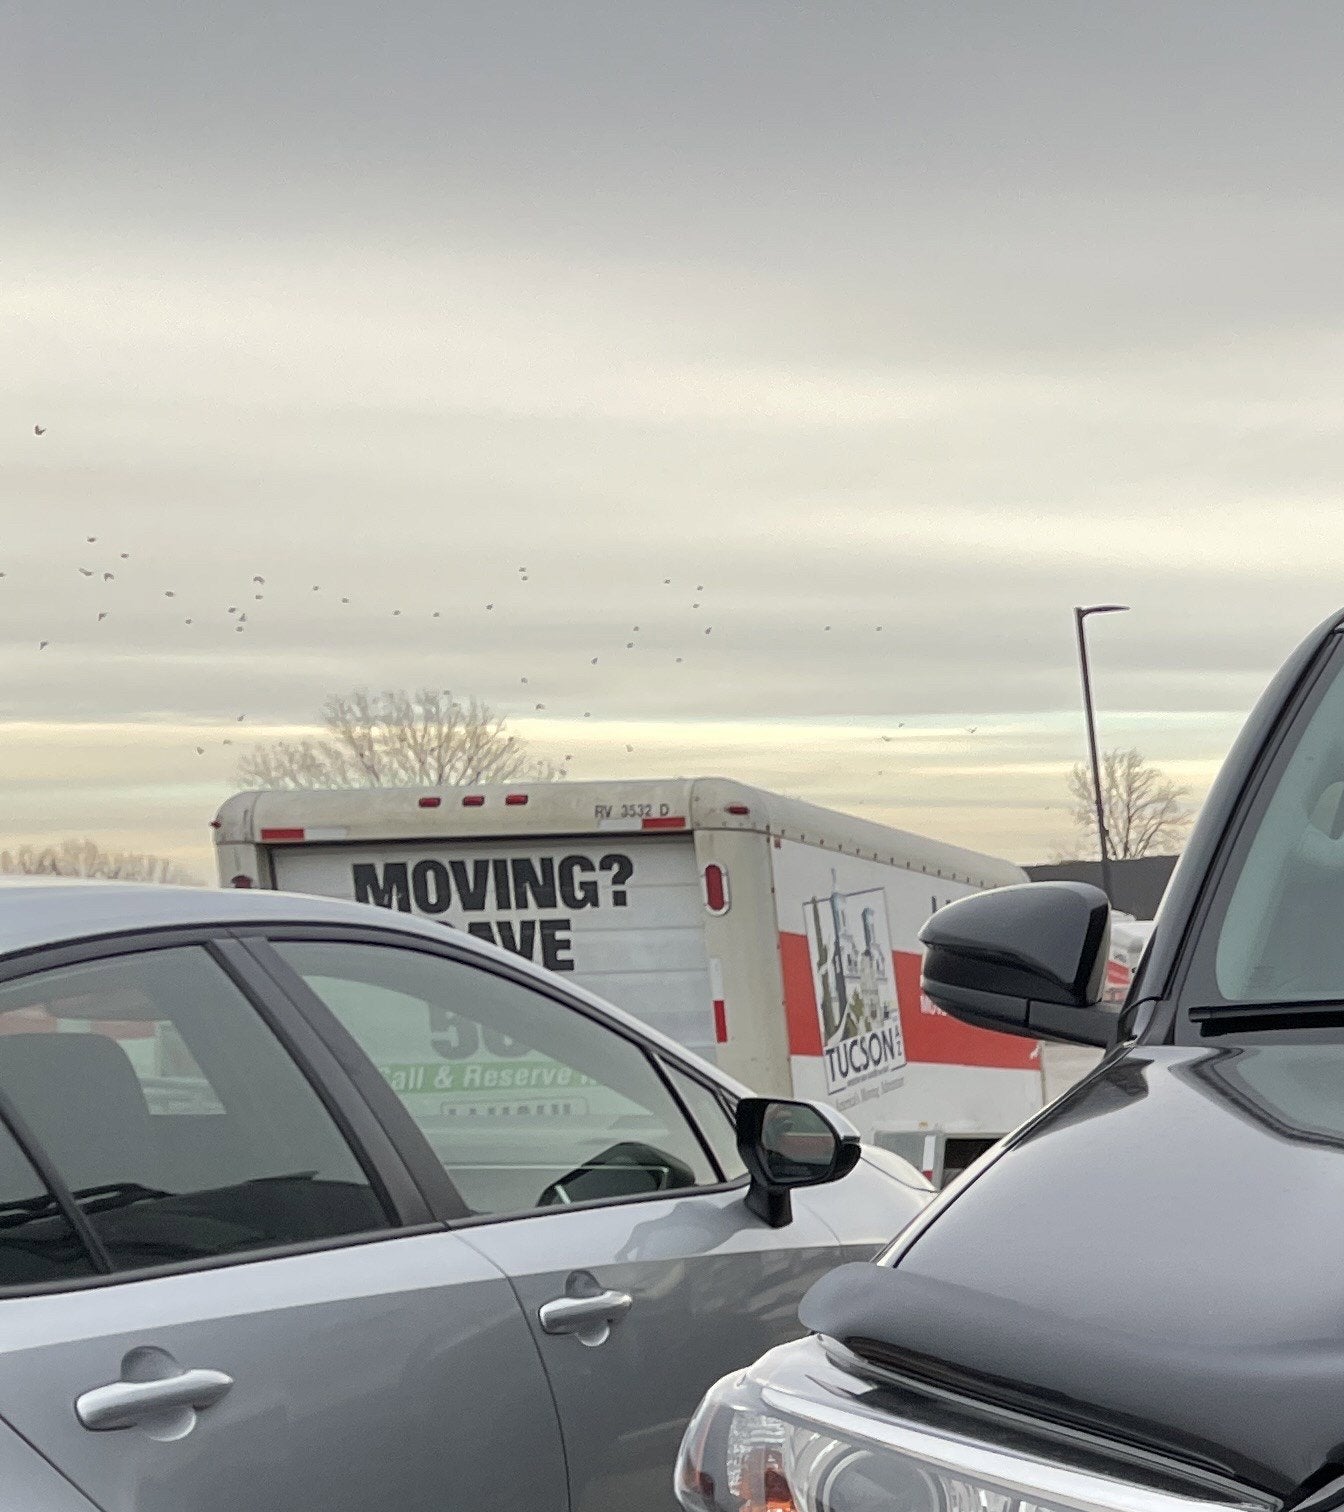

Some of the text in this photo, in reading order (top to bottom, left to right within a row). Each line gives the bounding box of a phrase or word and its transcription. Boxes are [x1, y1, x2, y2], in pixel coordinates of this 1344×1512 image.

[352, 854, 634, 914] MOVING?
[437, 919, 575, 971] AVE
[463, 1063, 573, 1088] Reserve
[825, 1027, 896, 1083] TUCSON
